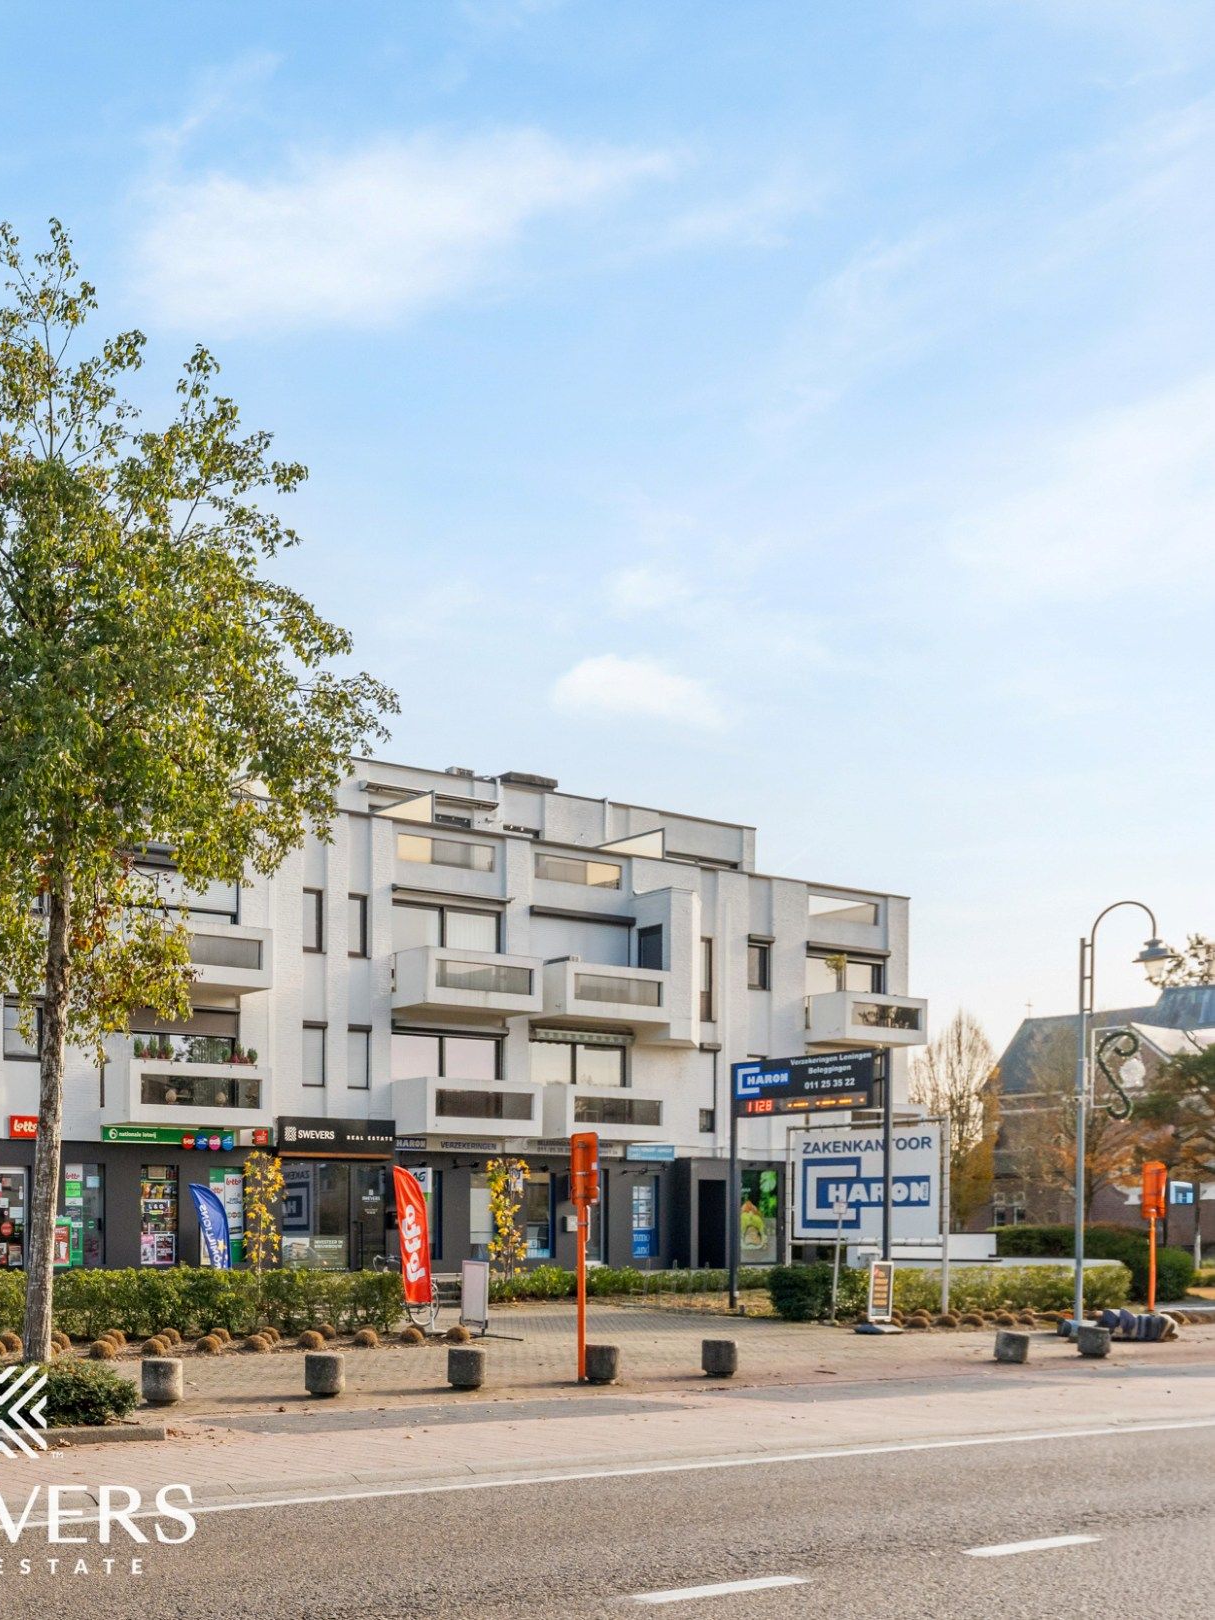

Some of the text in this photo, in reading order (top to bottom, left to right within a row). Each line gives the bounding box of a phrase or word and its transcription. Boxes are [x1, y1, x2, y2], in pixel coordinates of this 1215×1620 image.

[804, 1077, 855, 1090] 011 25 35 22
[297, 1129, 335, 1141] SWEVERS
[440, 1141, 498, 1151] VERZEKERINGEN
[802, 1136, 932, 1155] ZAKENKANOOR
